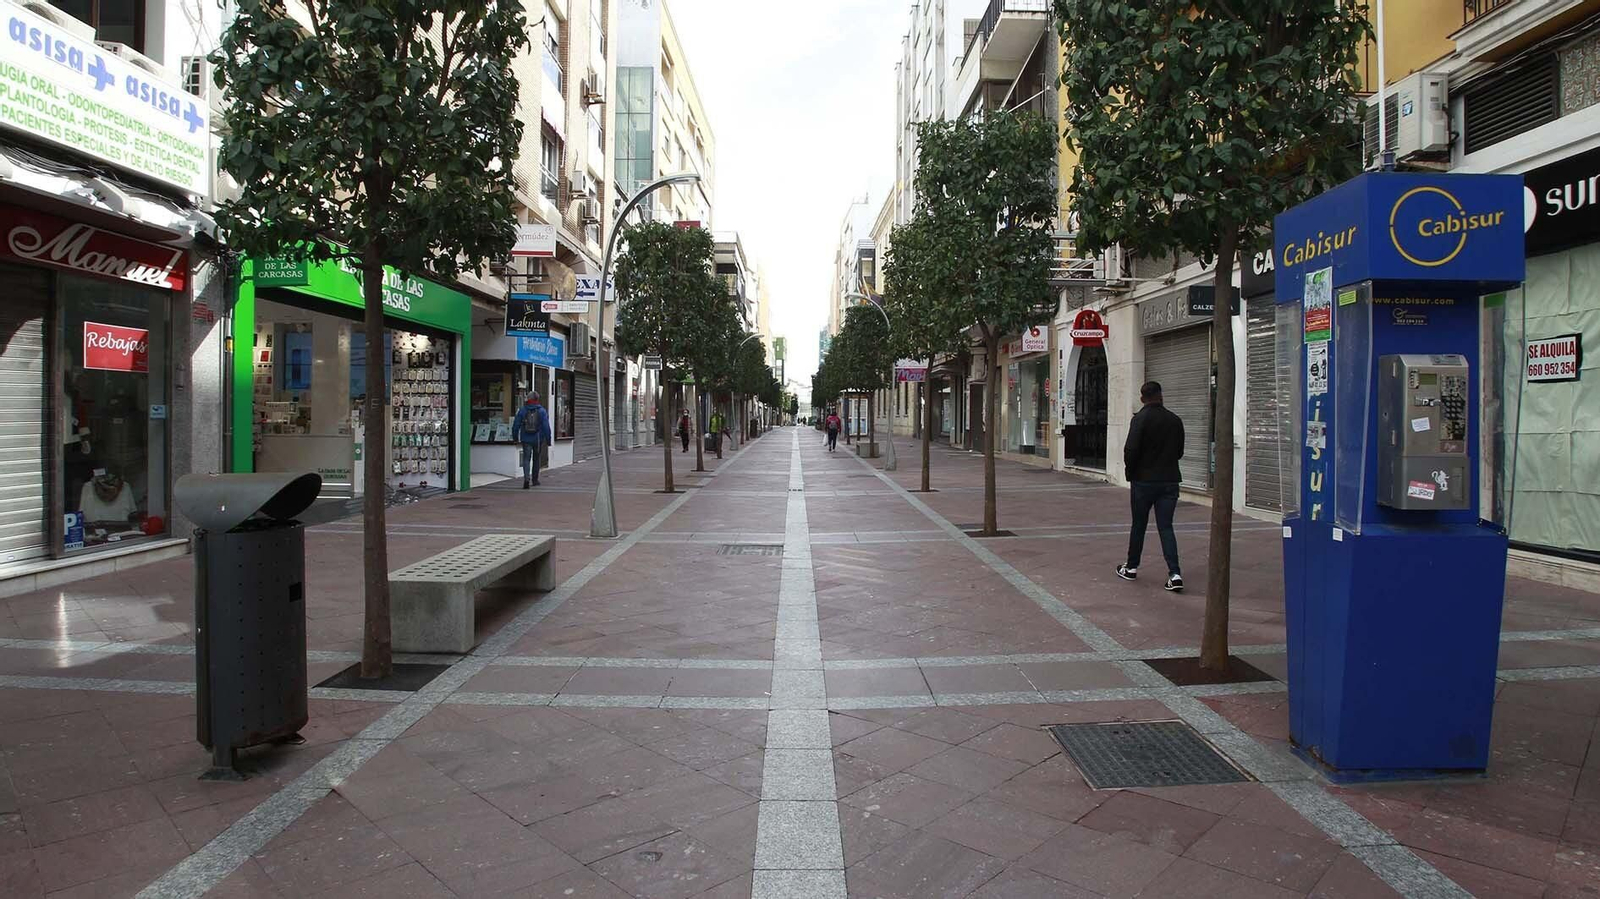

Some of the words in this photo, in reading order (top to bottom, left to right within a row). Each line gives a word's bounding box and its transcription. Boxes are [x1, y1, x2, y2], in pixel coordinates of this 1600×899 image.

[9, 16, 83, 72] asisa
[126, 74, 180, 118] asisa
[30, 75, 60, 100] ORAL
[68, 92, 151, 137] ODONTOPEDIATRIA
[157, 131, 204, 160] ORTODONCIA
[1, 103, 62, 138] PACIENTES
[64, 127, 121, 161] ESPECIALES
[131, 153, 141, 168] DE
[143, 159, 164, 176] ALTO
[165, 167, 192, 188] RIESGO
[83, 116, 128, 146] PROTESIS
[134, 137, 172, 162] ESTETICA
[173, 153, 201, 175] DENTAL
[516, 232, 549, 241] ermúdez
[1418, 209, 1504, 237] Cabisur
[8, 222, 183, 289] Manuel
[1283, 224, 1357, 268] Cabisur
[258, 270, 304, 279] CARCASAS
[264, 262, 276, 270] DE
[280, 262, 297, 270] LAS
[390, 273, 403, 291] DE
[406, 276, 424, 299] LAS
[86, 331, 148, 356] Rebajas
[1528, 344, 1538, 359] SE
[1540, 340, 1575, 357] ALQUILA
[1528, 363, 1542, 376] 660
[1544, 362, 1559, 376] 952
[1560, 361, 1575, 375] 354
